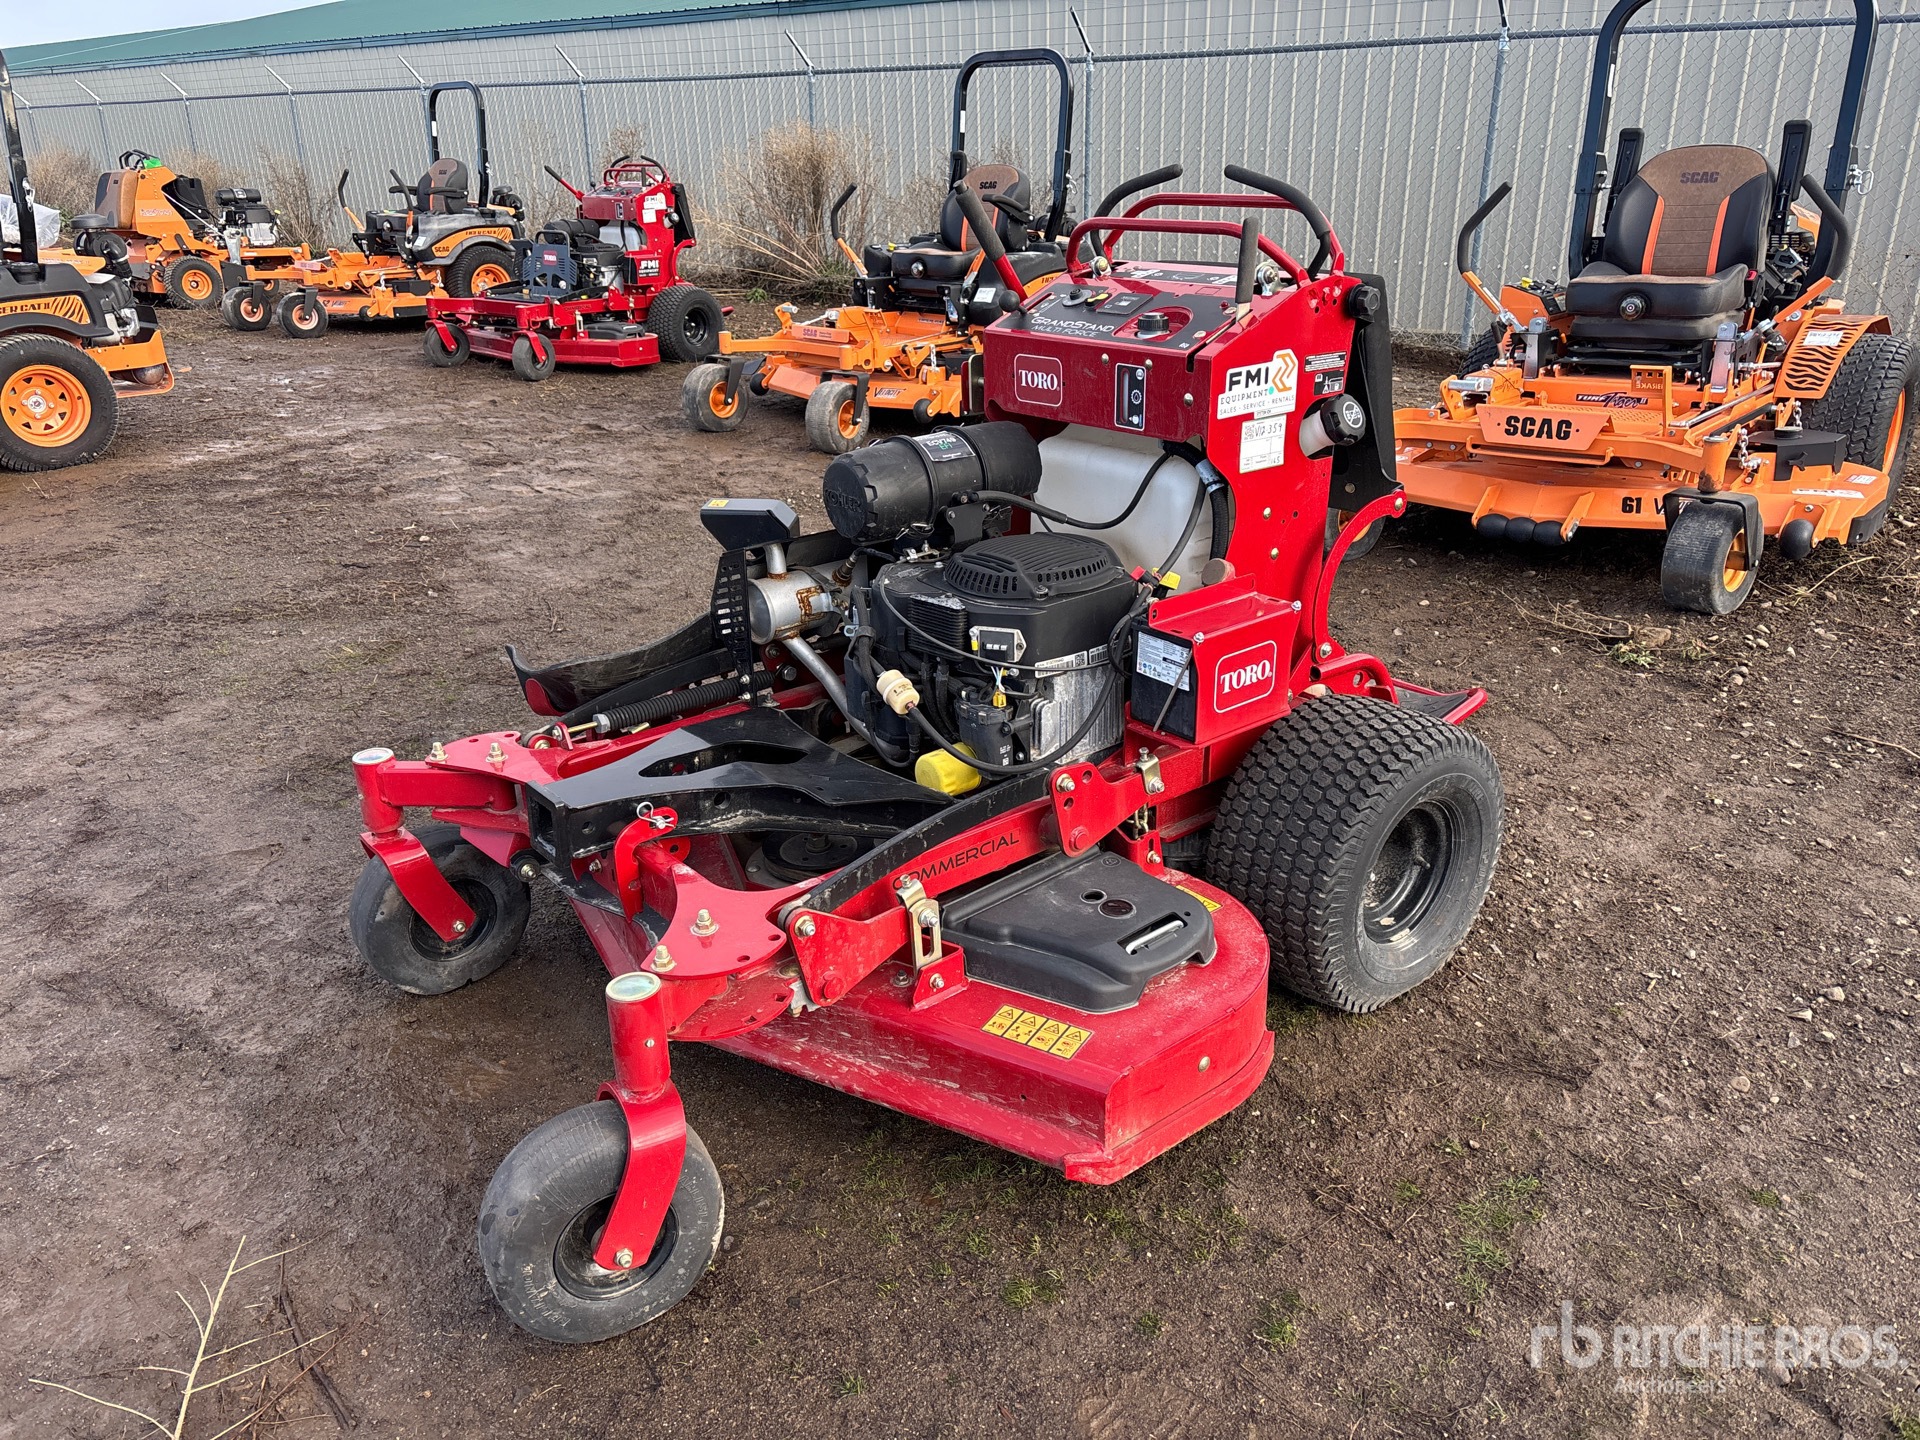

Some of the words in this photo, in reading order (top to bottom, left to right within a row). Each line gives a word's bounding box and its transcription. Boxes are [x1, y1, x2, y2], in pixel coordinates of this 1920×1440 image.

[979, 181, 998, 190] SCAG
[1680, 171, 1720, 184] SCAG
[640, 260, 659, 269] FMI
[20, 302, 42, 311] CAT
[1031, 324, 1062, 333] MULTI
[1061, 328, 1099, 338] FORCE
[1018, 369, 1058, 391] TORO
[1228, 366, 1269, 392] FMI
[1219, 406, 1238, 416] SALES
[1243, 400, 1267, 411] SERVICE
[1271, 394, 1295, 404] RENTALS
[1220, 388, 1268, 405] EQUIPMENT
[1504, 415, 1573, 441] SCAG
[1621, 497, 1642, 513] 61
[1220, 659, 1271, 694] TORO
[892, 832, 1020, 891] COMMERCIAL
